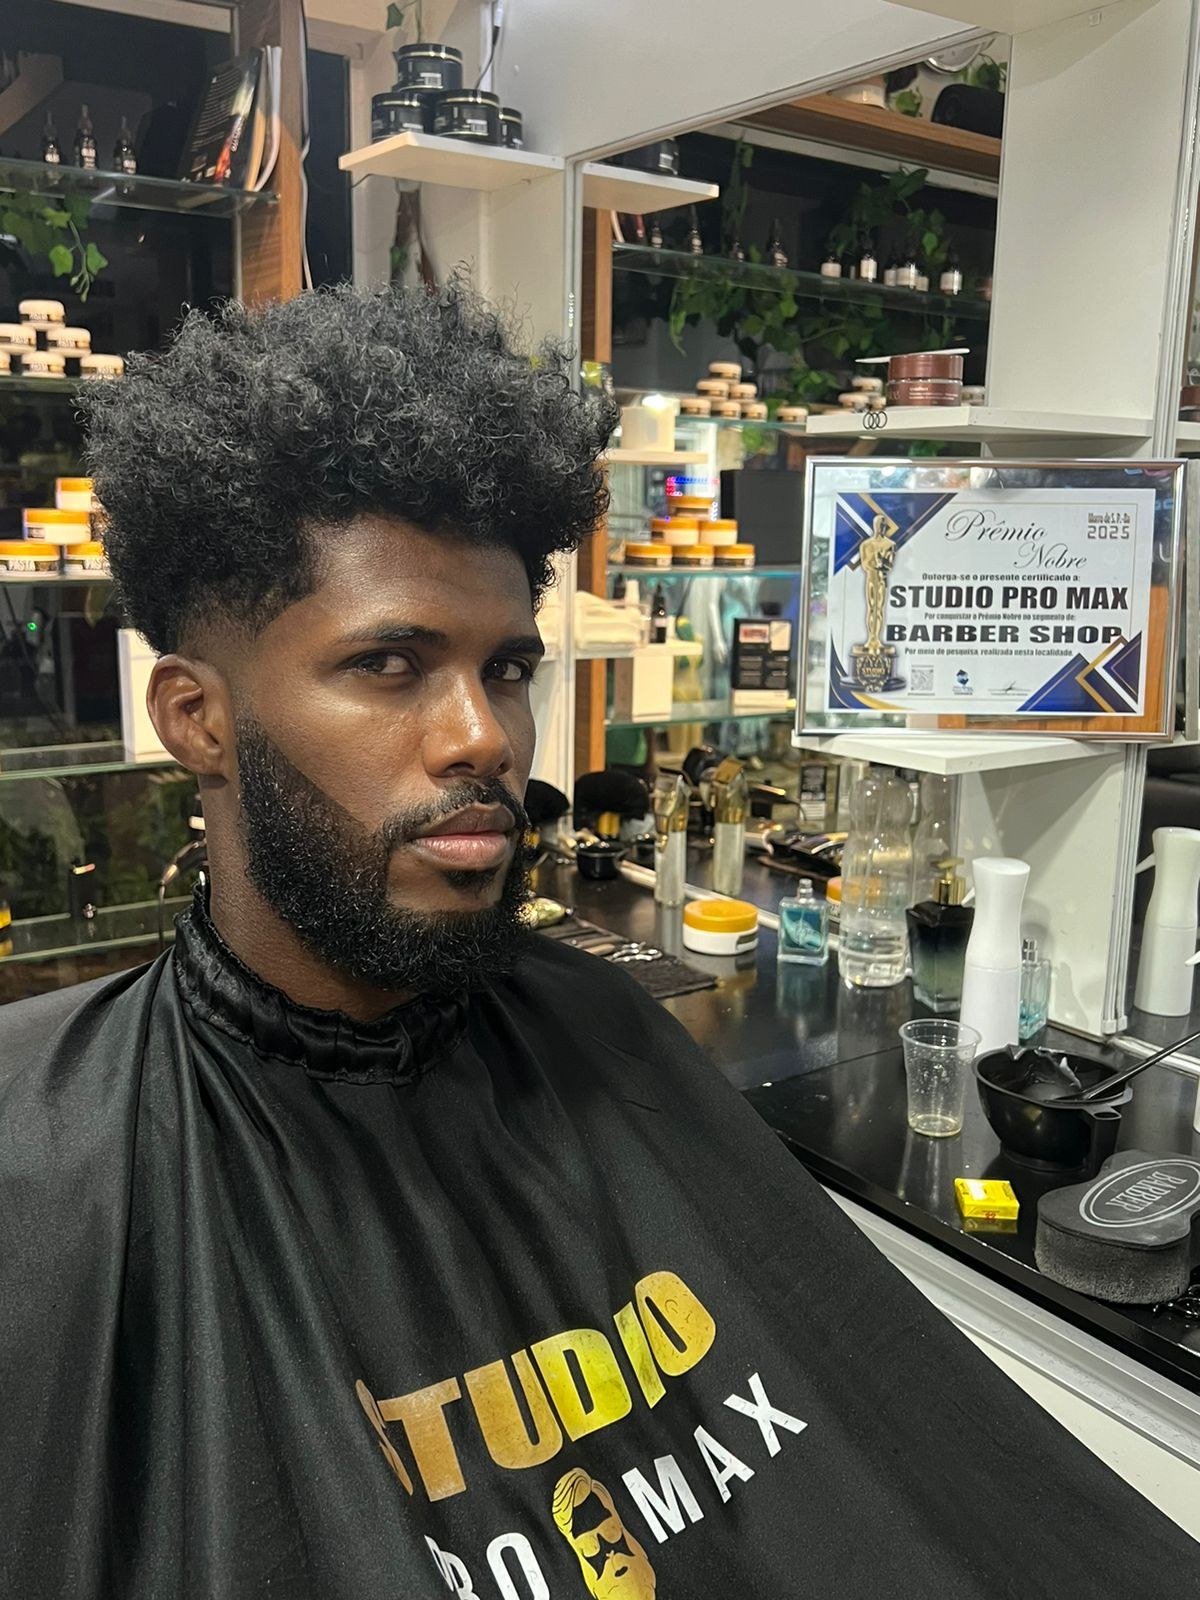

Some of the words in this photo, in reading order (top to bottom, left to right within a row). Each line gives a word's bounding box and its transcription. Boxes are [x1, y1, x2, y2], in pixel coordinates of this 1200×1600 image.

[1087, 525, 1130, 540] 2025
[1013, 543, 1088, 569] Nobre
[922, 573, 970, 582] Outorga-se
[979, 574, 1020, 583] presente
[1021, 573, 1071, 581] certificado
[890, 585, 993, 608] STUDIO
[1002, 586, 1058, 609] PRO
[1066, 587, 1128, 610] MAX
[1002, 613, 1021, 621] Nobre
[1033, 614, 1064, 622] segmento
[886, 624, 1019, 643] BARBER
[1029, 625, 1122, 644] SHOP
[904, 647, 916, 655] Por
[917, 647, 935, 655] meio
[980, 648, 1013, 656] realizada
[1014, 648, 1034, 656] nesta
[1105, 1171, 1187, 1212] BARBER
[621, 1372, 809, 1544] MAX
